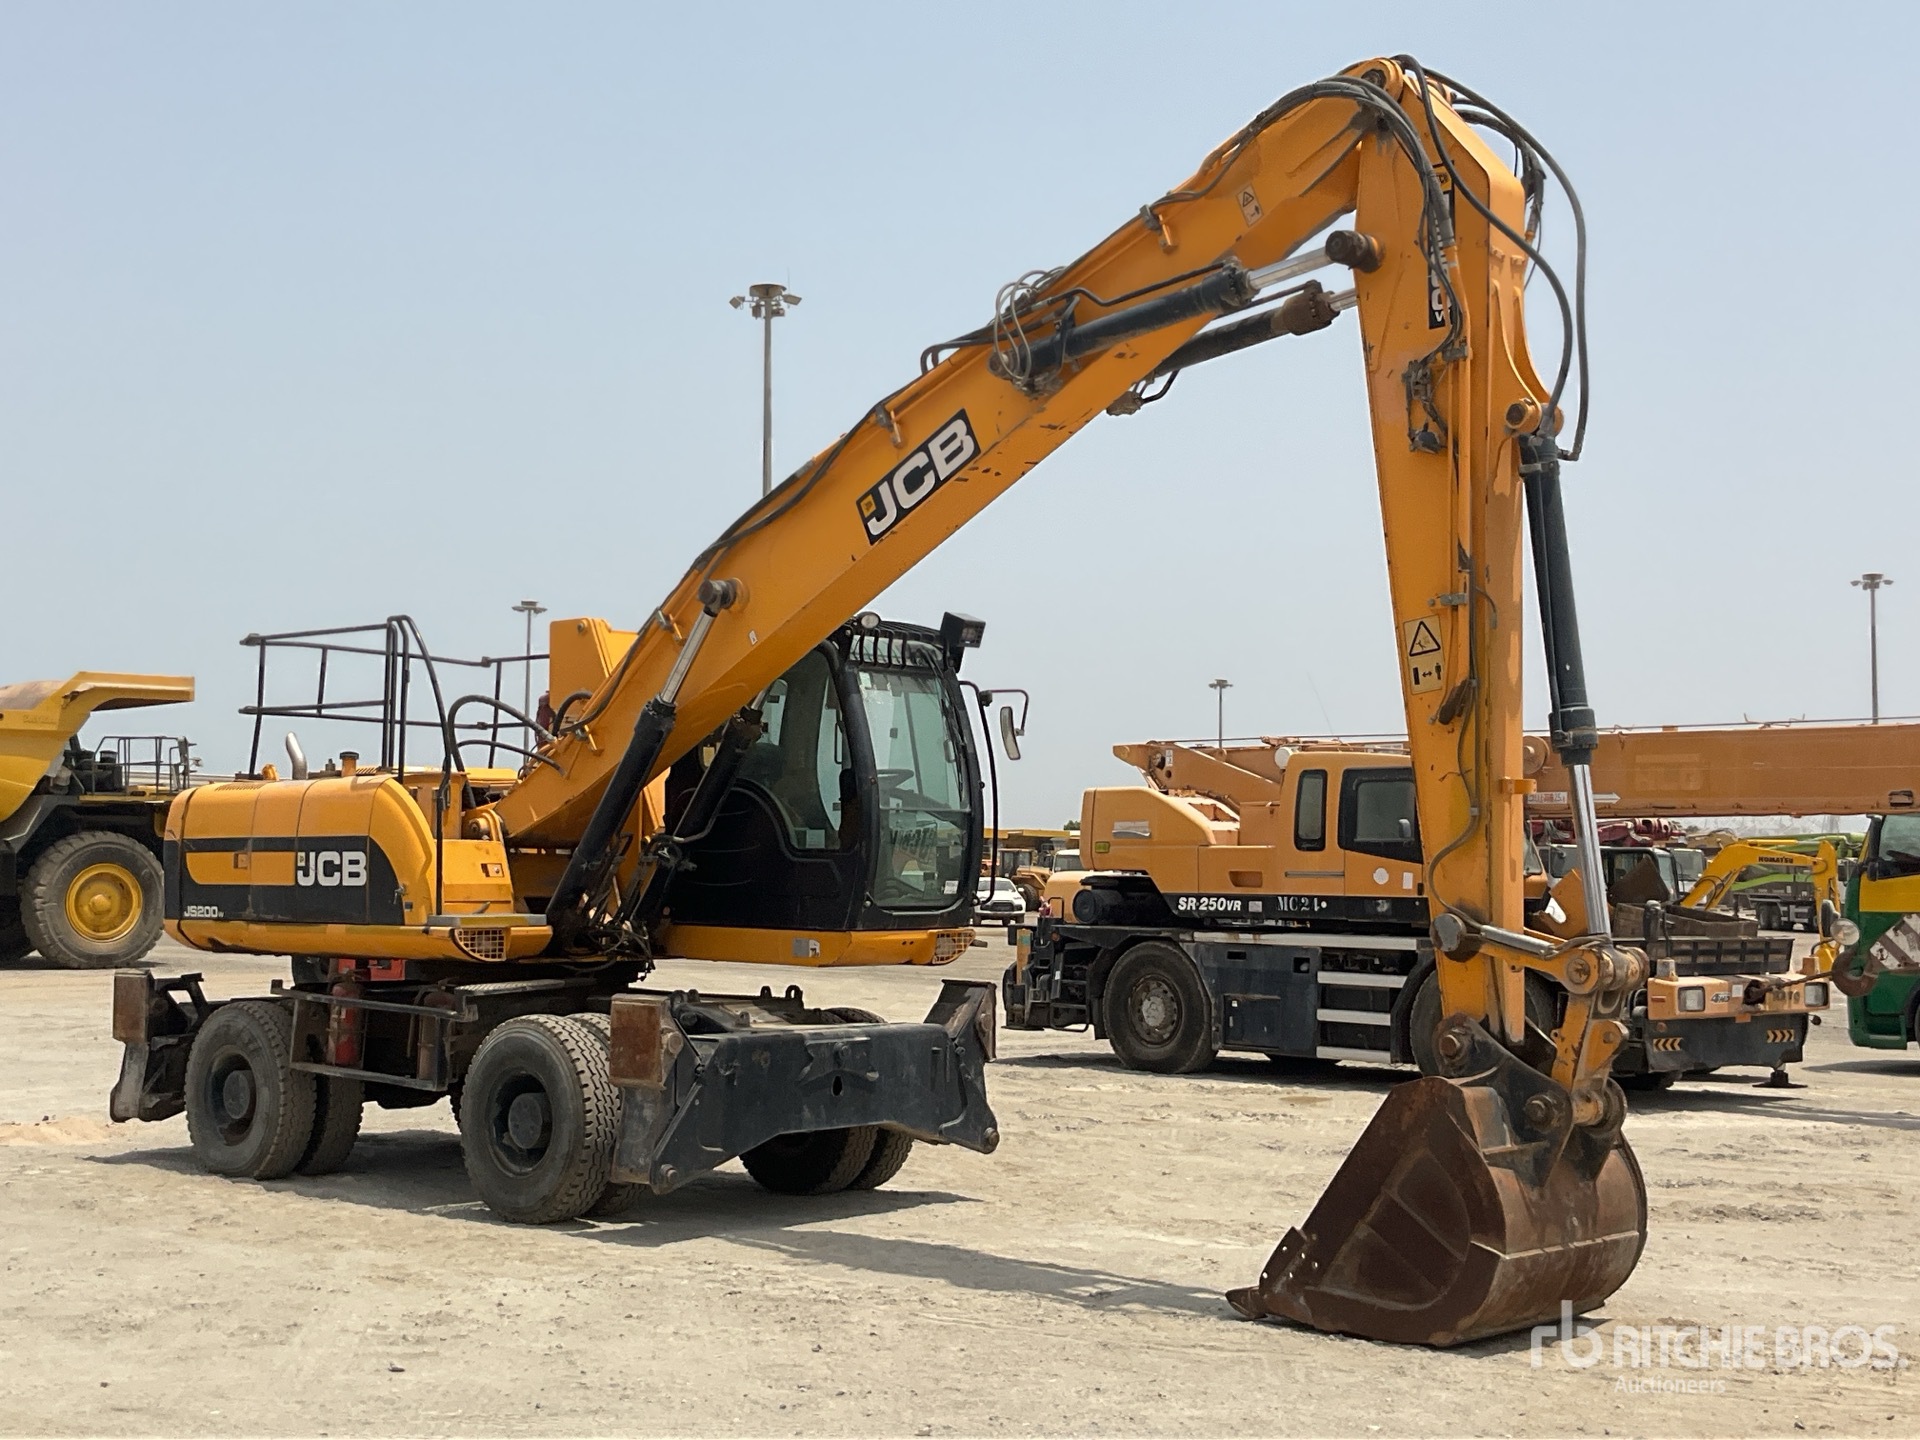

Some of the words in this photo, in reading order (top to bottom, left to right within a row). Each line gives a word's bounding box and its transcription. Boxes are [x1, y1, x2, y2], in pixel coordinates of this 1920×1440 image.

[867, 419, 975, 536] JCB
[297, 851, 367, 886] JCB
[1758, 856, 1794, 864] KOMATSU
